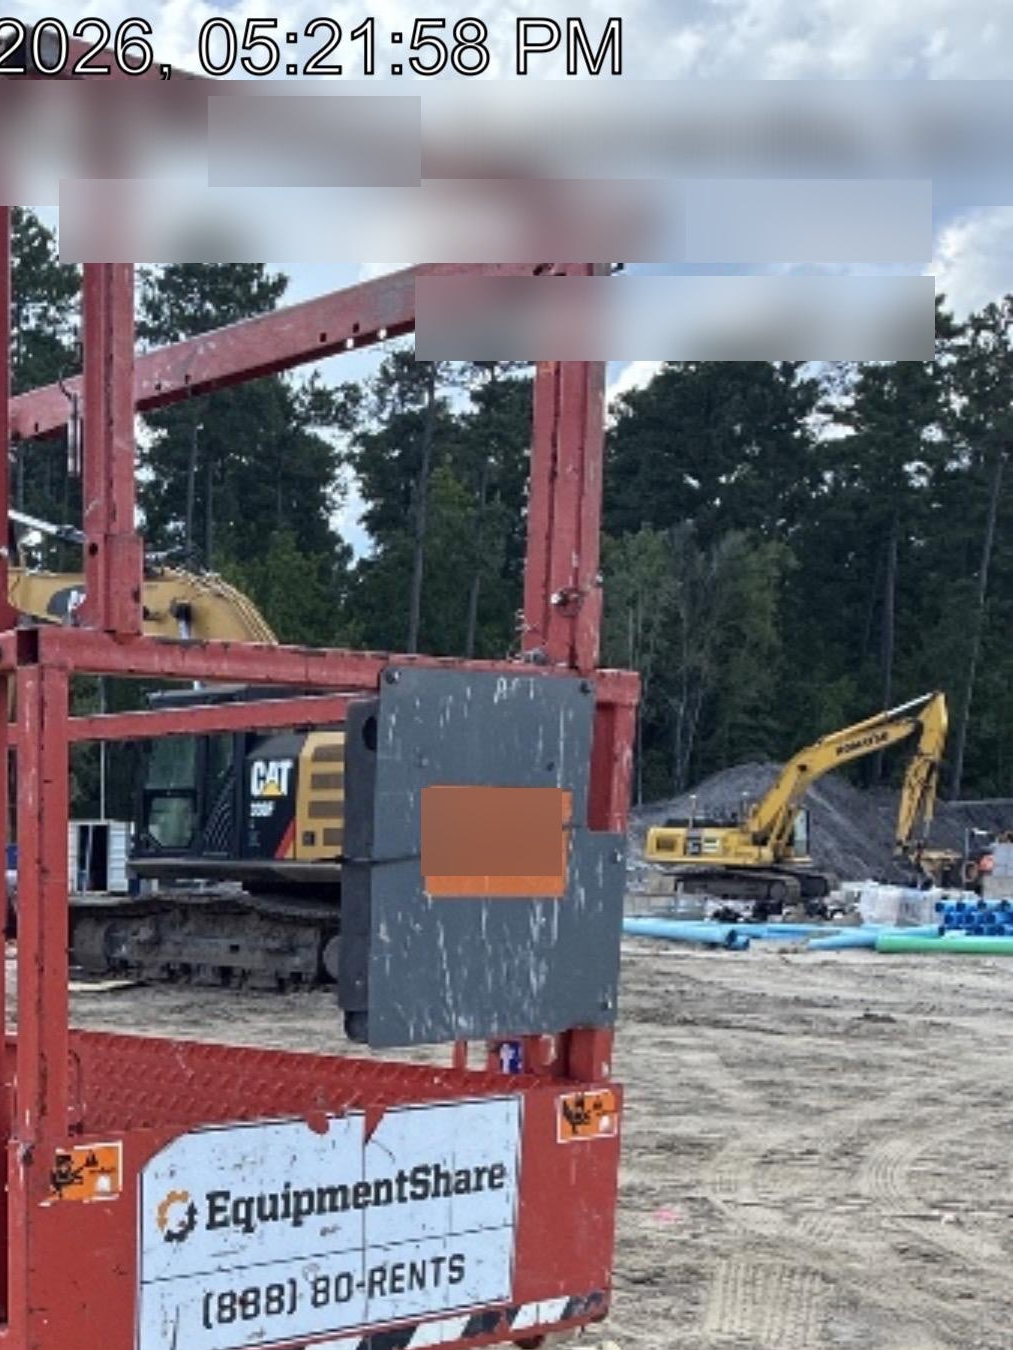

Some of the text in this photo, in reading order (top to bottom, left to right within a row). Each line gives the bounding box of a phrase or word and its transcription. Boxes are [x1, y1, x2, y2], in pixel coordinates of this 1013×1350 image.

[250, 759, 293, 796] CAT
[205, 1161, 506, 1234] EquipmentShare
[202, 1253, 466, 1330] (888) 80-RENTS
